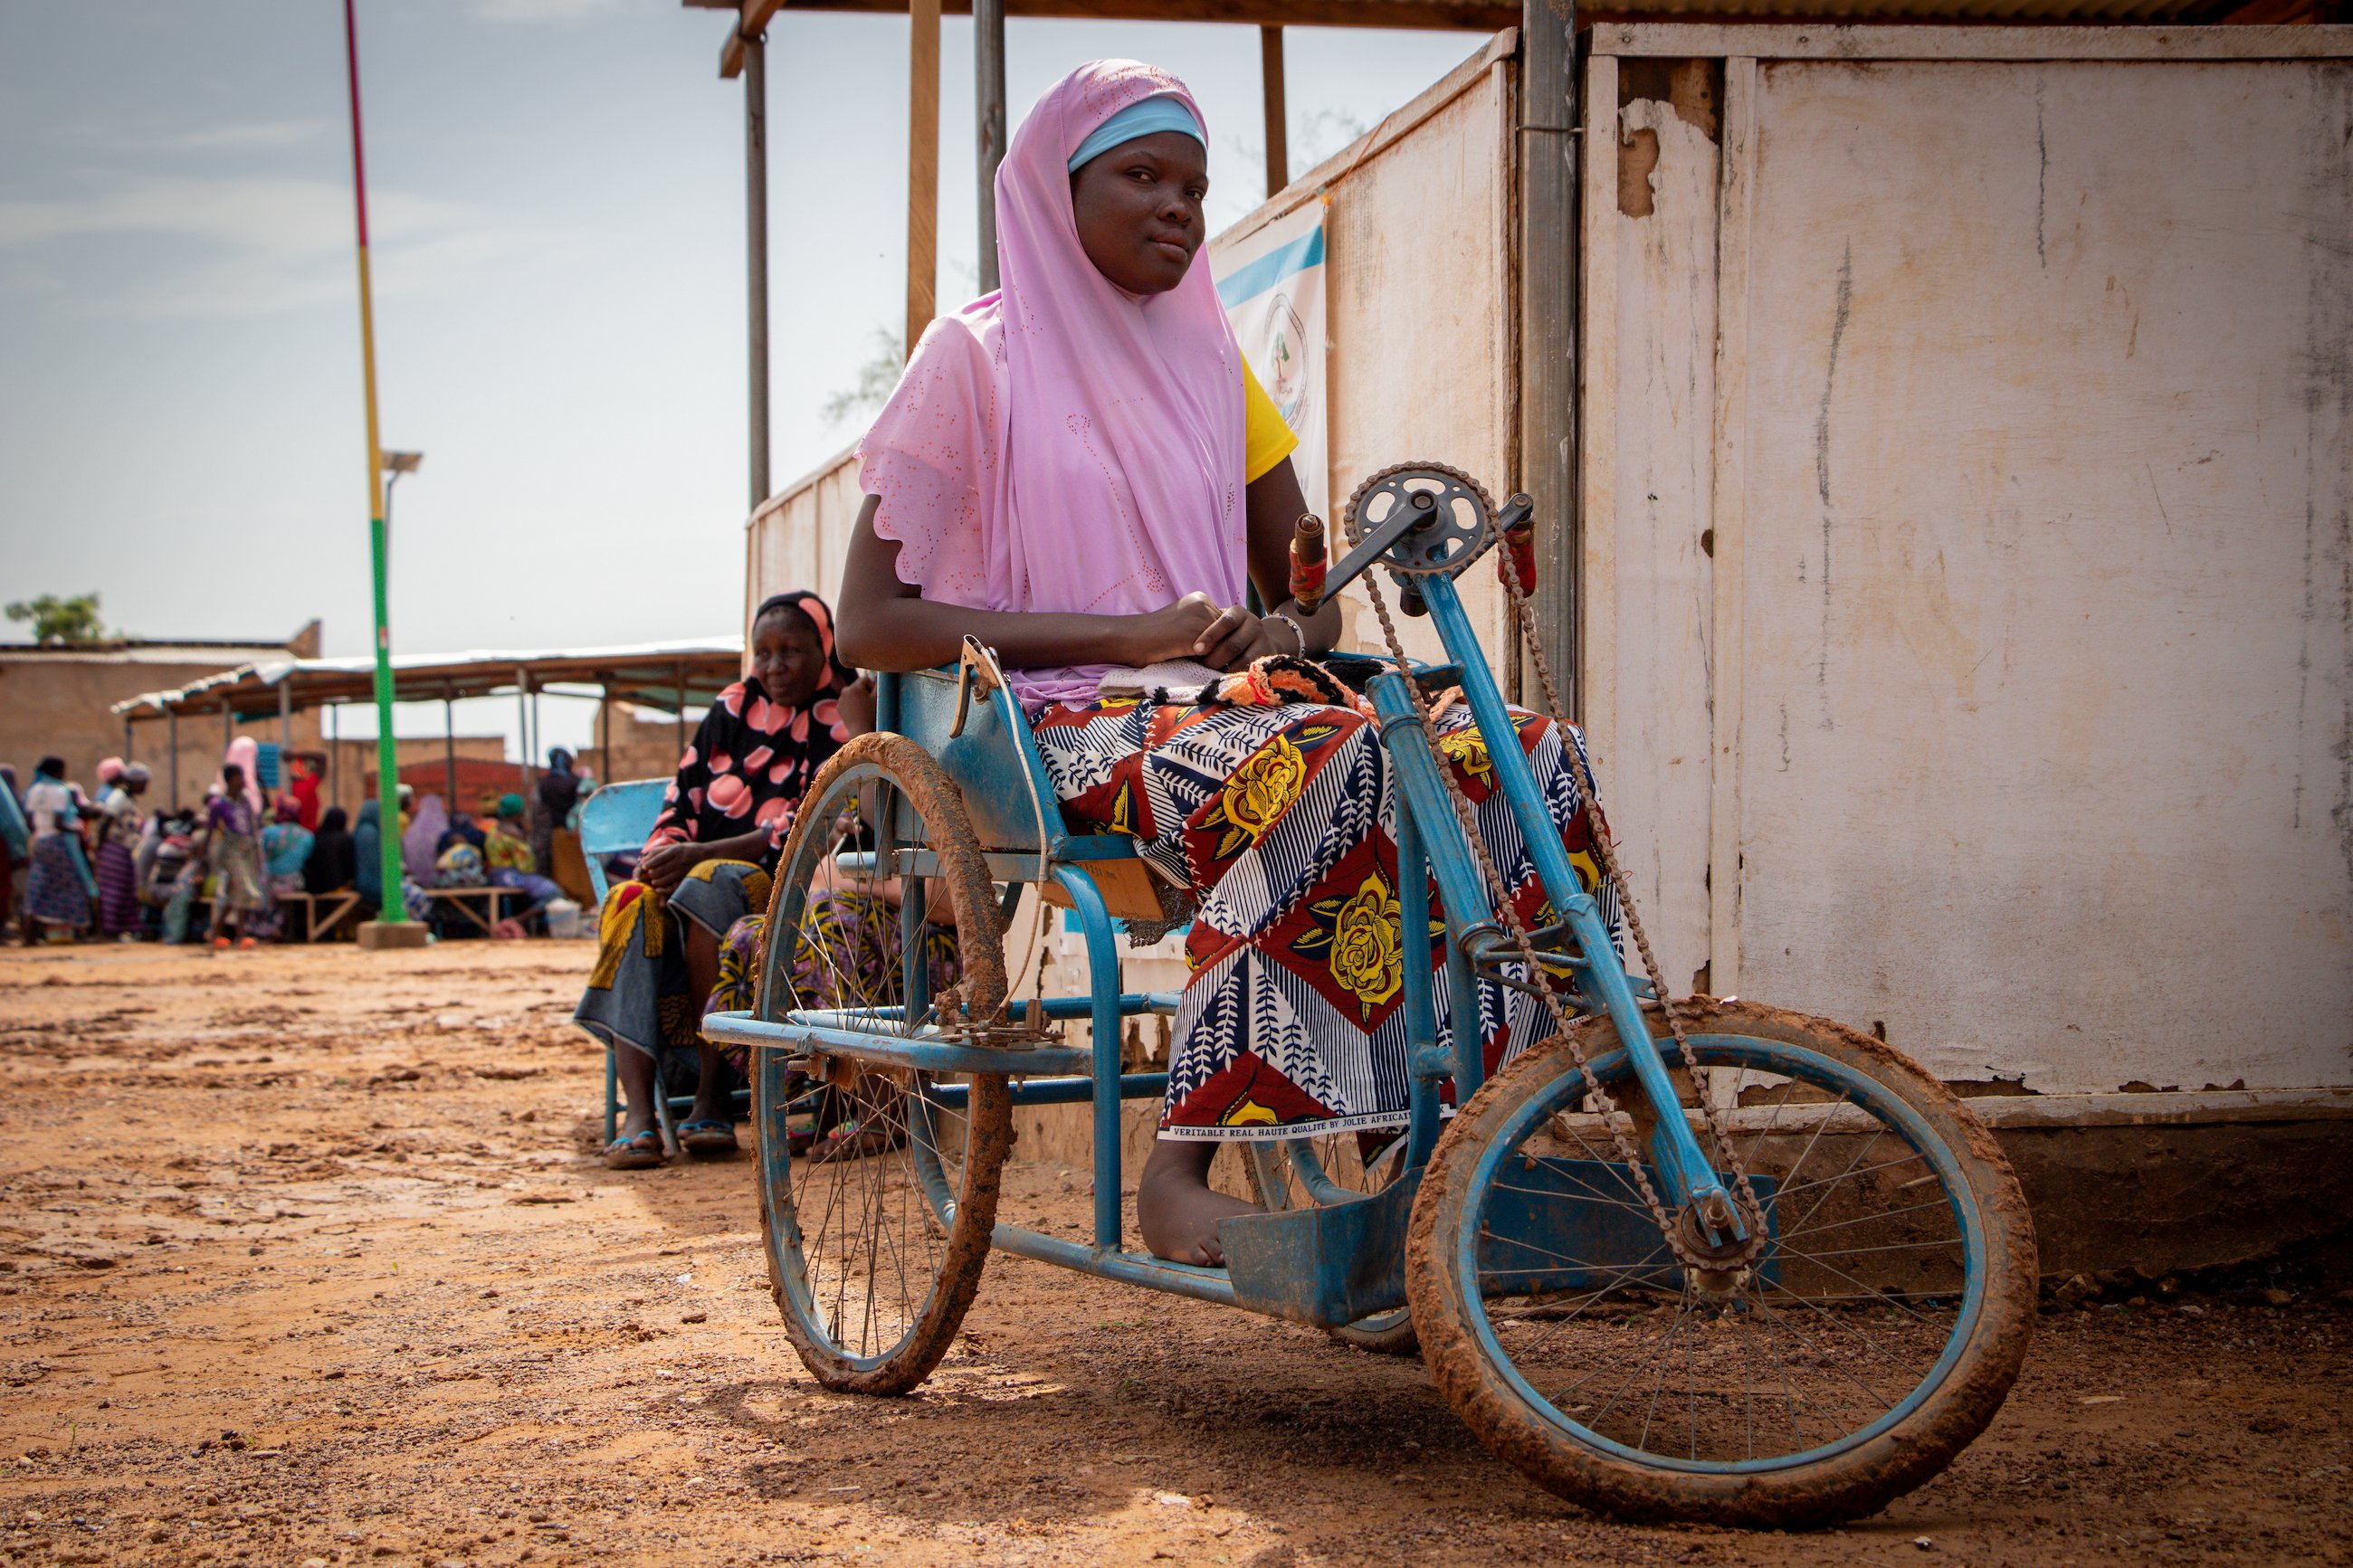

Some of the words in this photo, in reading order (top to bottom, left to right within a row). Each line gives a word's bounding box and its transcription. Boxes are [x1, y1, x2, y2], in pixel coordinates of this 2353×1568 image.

[1174, 1127, 1225, 1137] VERITABLE
[1229, 1129, 1253, 1137] REAL
[1258, 1127, 1289, 1136] HAUTE
[1291, 1123, 1326, 1134] QUALITE
[1329, 1120, 1339, 1129] BY
[1342, 1117, 1367, 1126] JOLIE
[1371, 1112, 1411, 1124] AFRICAI
